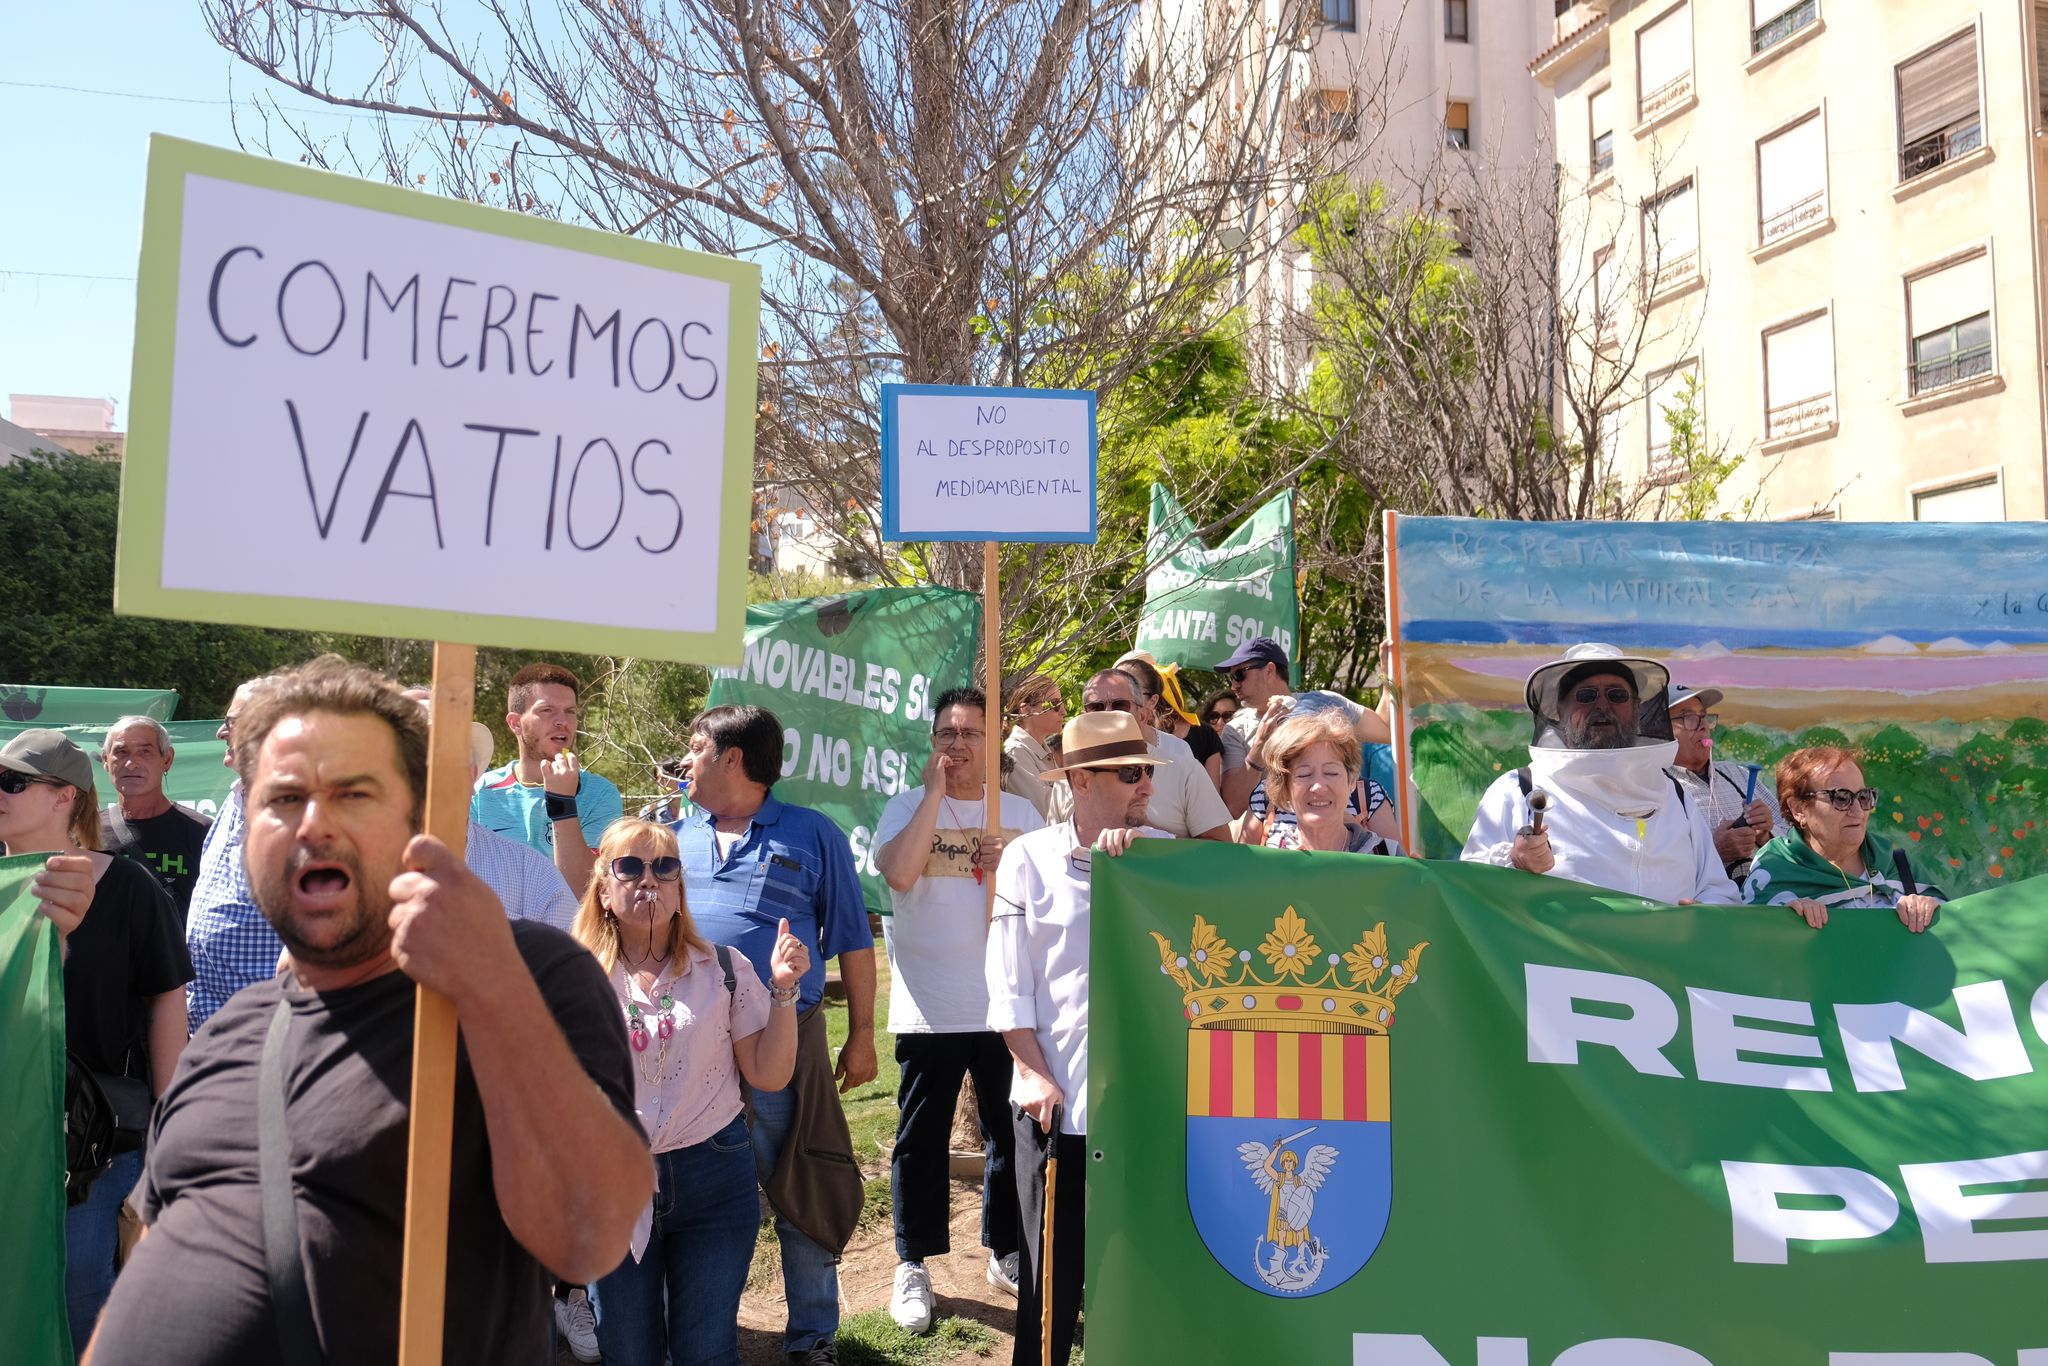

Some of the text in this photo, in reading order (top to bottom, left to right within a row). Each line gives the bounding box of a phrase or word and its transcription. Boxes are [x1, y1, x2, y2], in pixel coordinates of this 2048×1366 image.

[208, 245, 718, 401] COMEREMOS
[976, 405, 1007, 426] NO
[916, 439, 938, 457] AL
[285, 399, 683, 553] VATIOS
[1451, 528, 1642, 567] RESPETAR
[1711, 540, 1837, 566] BELLEZA
[1455, 577, 1802, 609] DE LA NATURALEZA
[1139, 609, 1217, 642] PLANTA
[713, 635, 902, 715] NOVABLES
[807, 733, 851, 787] NO
[930, 834, 970, 861] Pepe
[1523, 962, 2048, 1093] REN
[1720, 1150, 2048, 1265] PE
